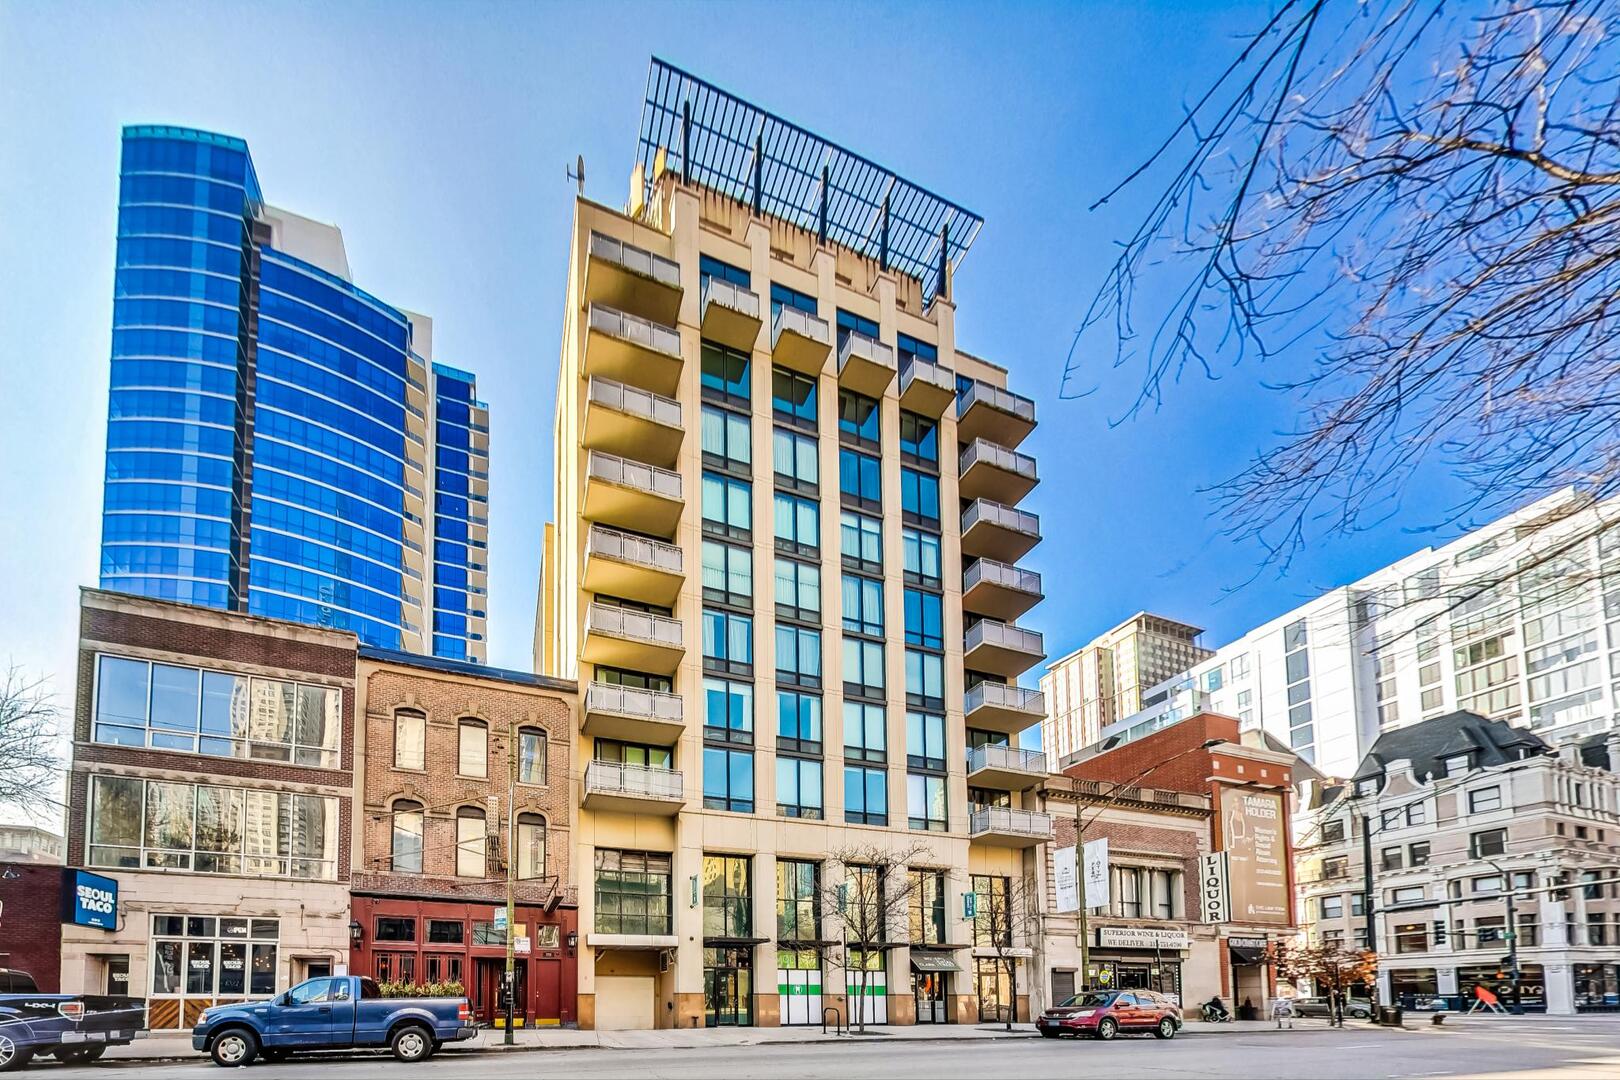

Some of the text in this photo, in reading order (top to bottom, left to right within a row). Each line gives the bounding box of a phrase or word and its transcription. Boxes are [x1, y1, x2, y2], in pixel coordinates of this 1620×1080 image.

[1242, 796, 1277, 809] TAMARA
[1245, 807, 1276, 819] HOLDER
[77, 885, 115, 904] SEOUL
[1206, 856, 1221, 921] LIQUOR
[80, 897, 112, 914] TACO
